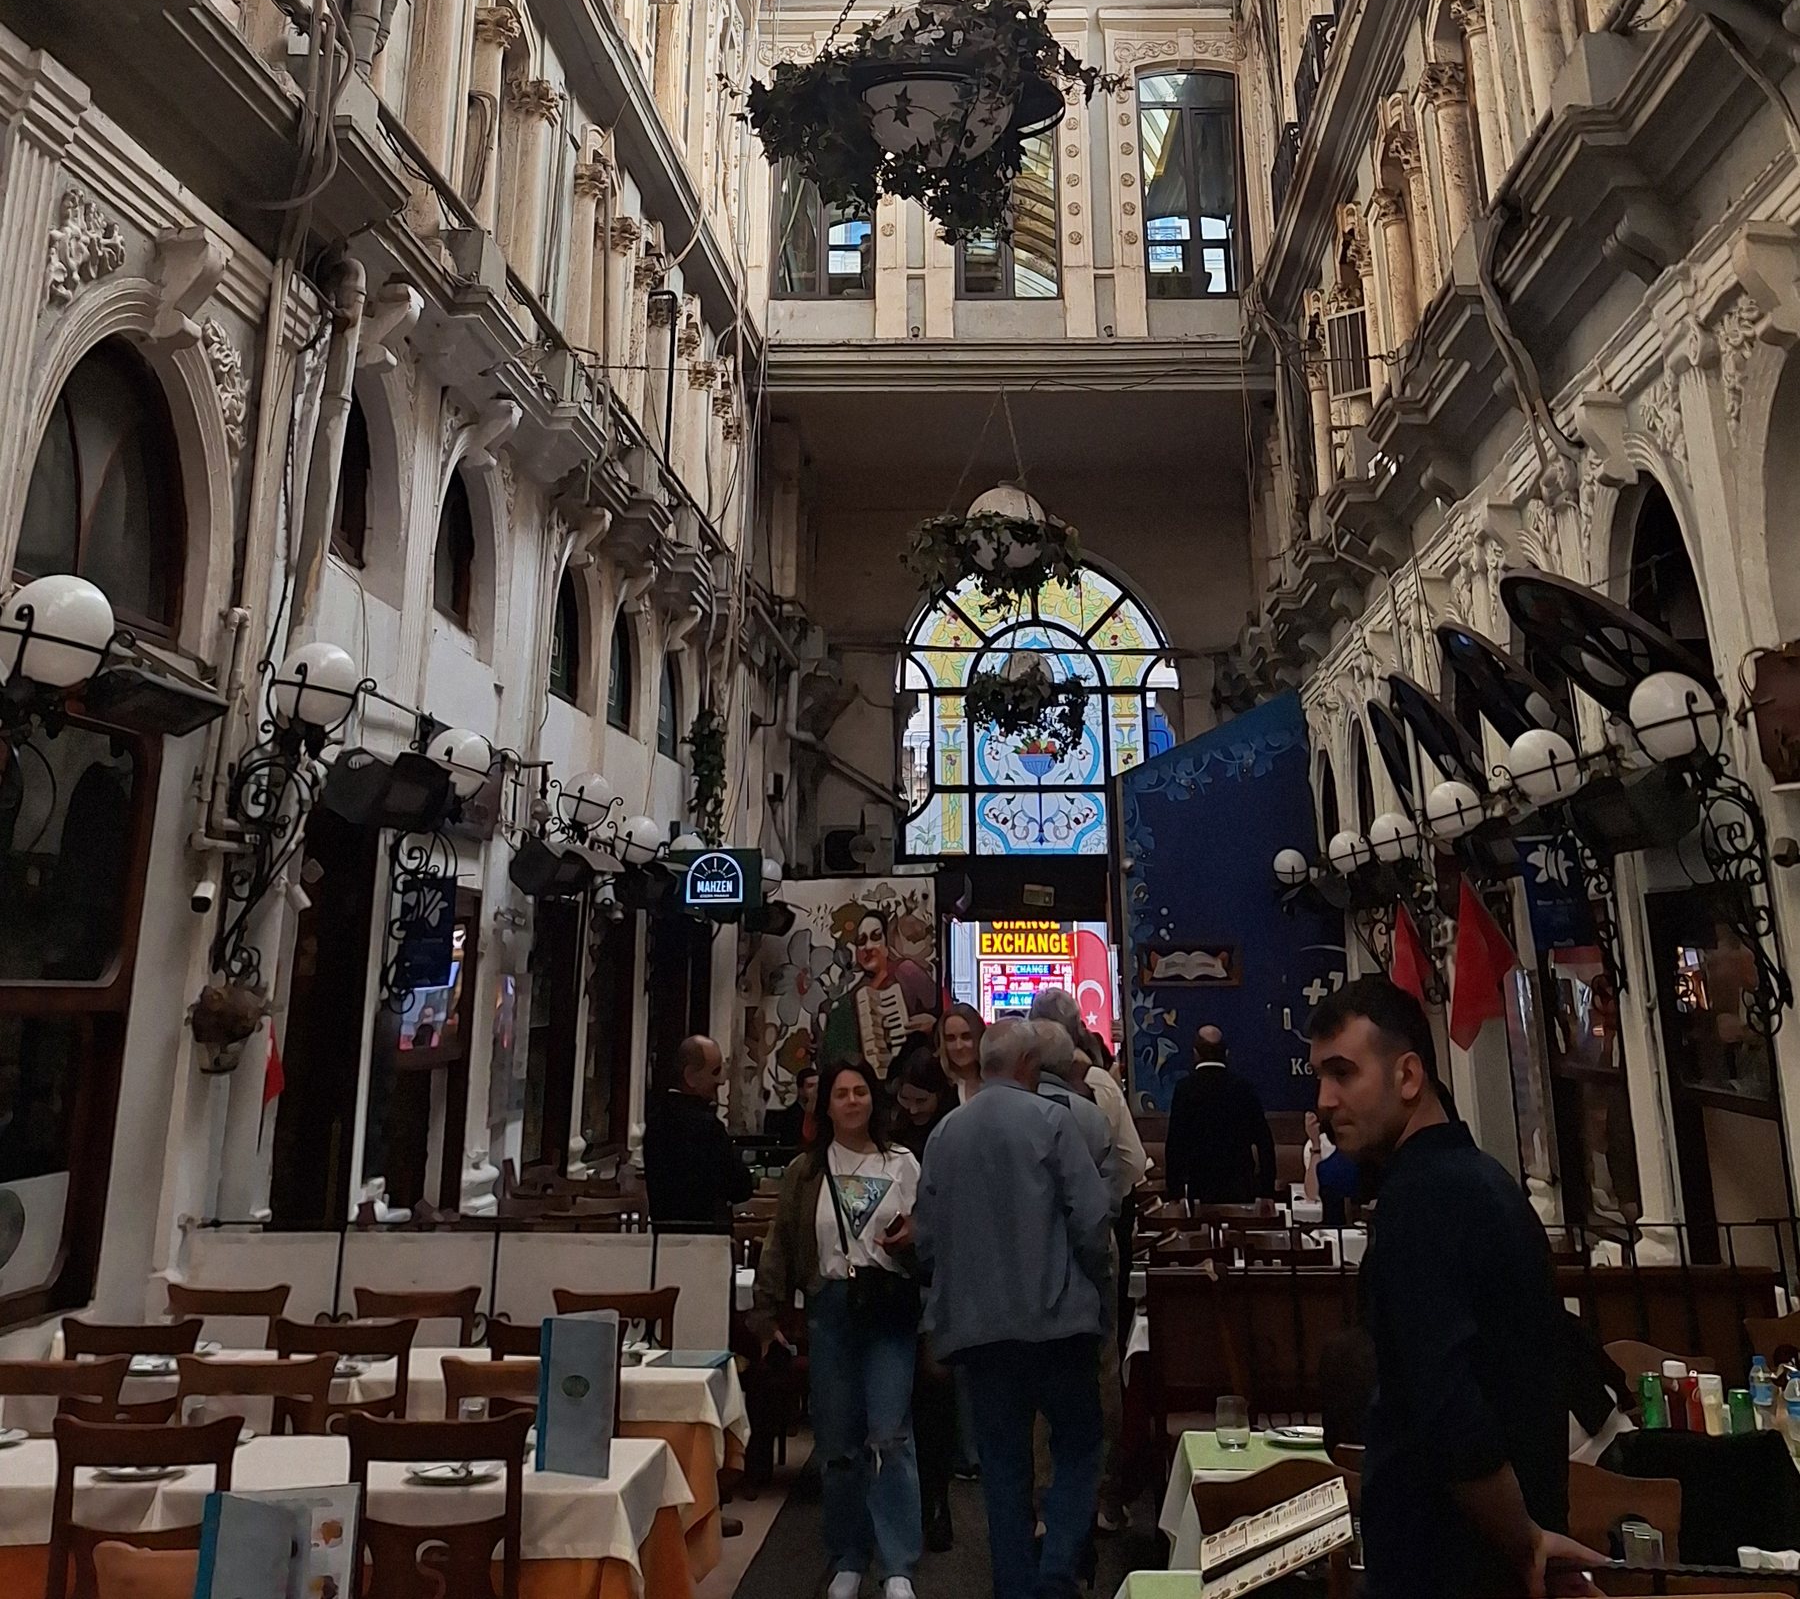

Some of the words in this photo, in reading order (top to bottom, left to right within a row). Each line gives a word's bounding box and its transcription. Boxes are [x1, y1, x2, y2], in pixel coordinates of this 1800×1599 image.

[697, 880, 733, 893] MAHZEN
[981, 932, 1069, 954] EXCHANGE
[1005, 964, 1049, 974] EXCHANGE
